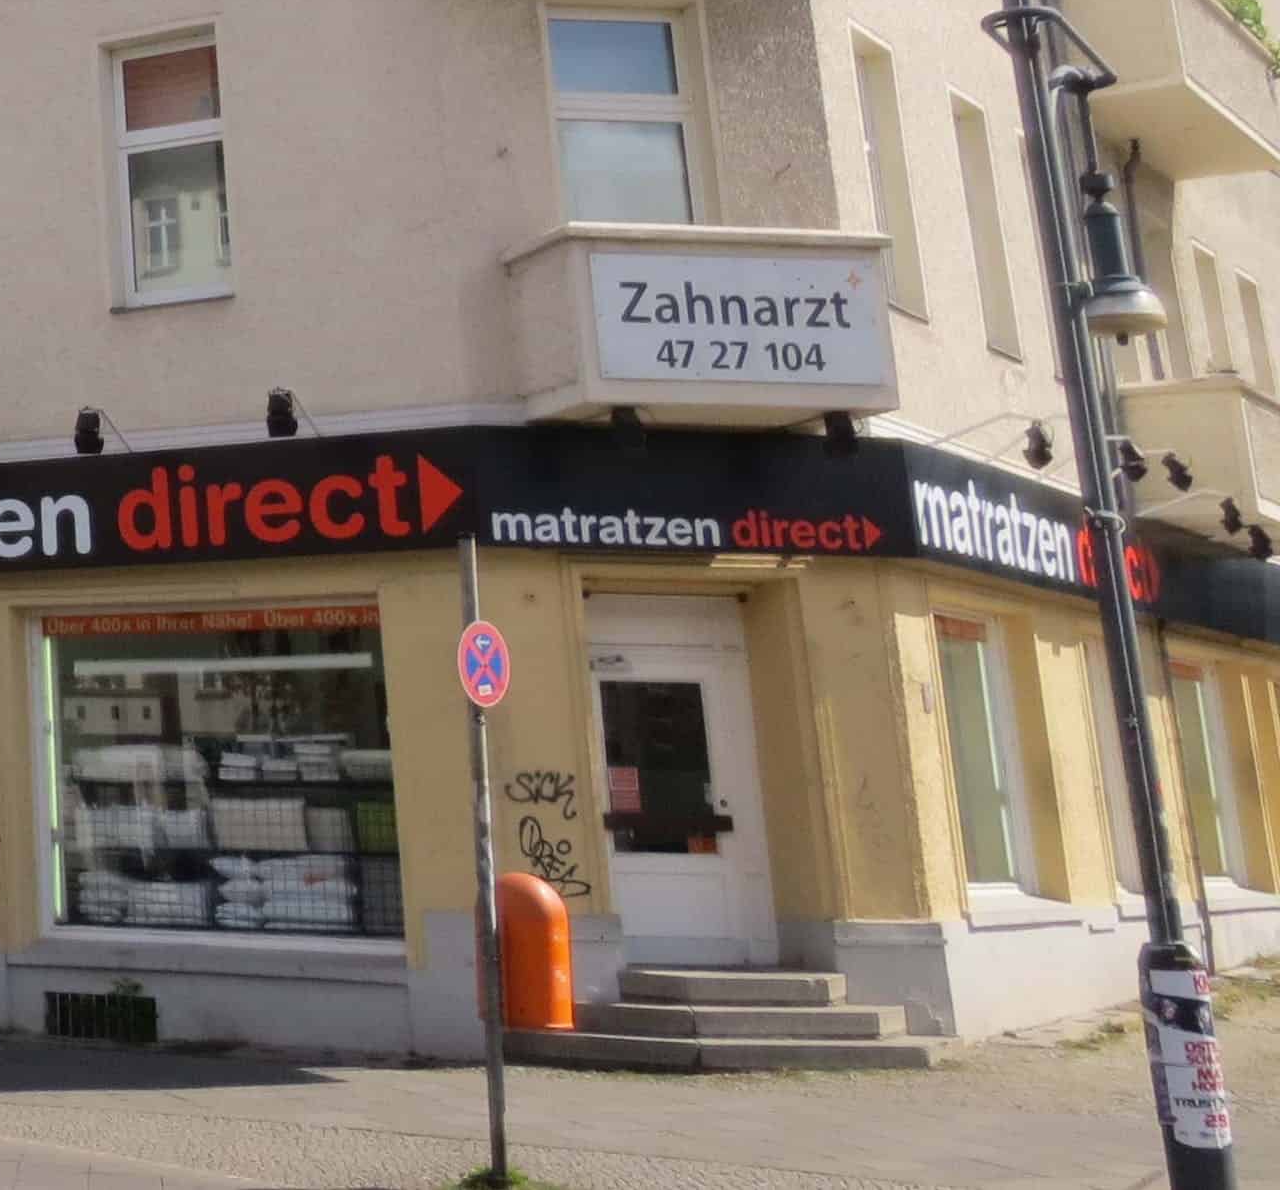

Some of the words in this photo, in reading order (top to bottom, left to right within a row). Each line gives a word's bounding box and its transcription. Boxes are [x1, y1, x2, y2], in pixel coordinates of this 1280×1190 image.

[618, 281, 851, 329] Zahnarzt
[656, 339, 695, 369] 47
[710, 340, 748, 370] 27
[764, 342, 827, 371] 104
[118, 454, 410, 552] direct
[492, 507, 721, 547] matratzen
[731, 509, 867, 550] direct
[914, 479, 1076, 583] matratzen
[46, 617, 86, 634] Über
[91, 617, 131, 632] 400x
[137, 616, 151, 631] in
[263, 608, 304, 628] Über
[311, 608, 357, 627] 400x
